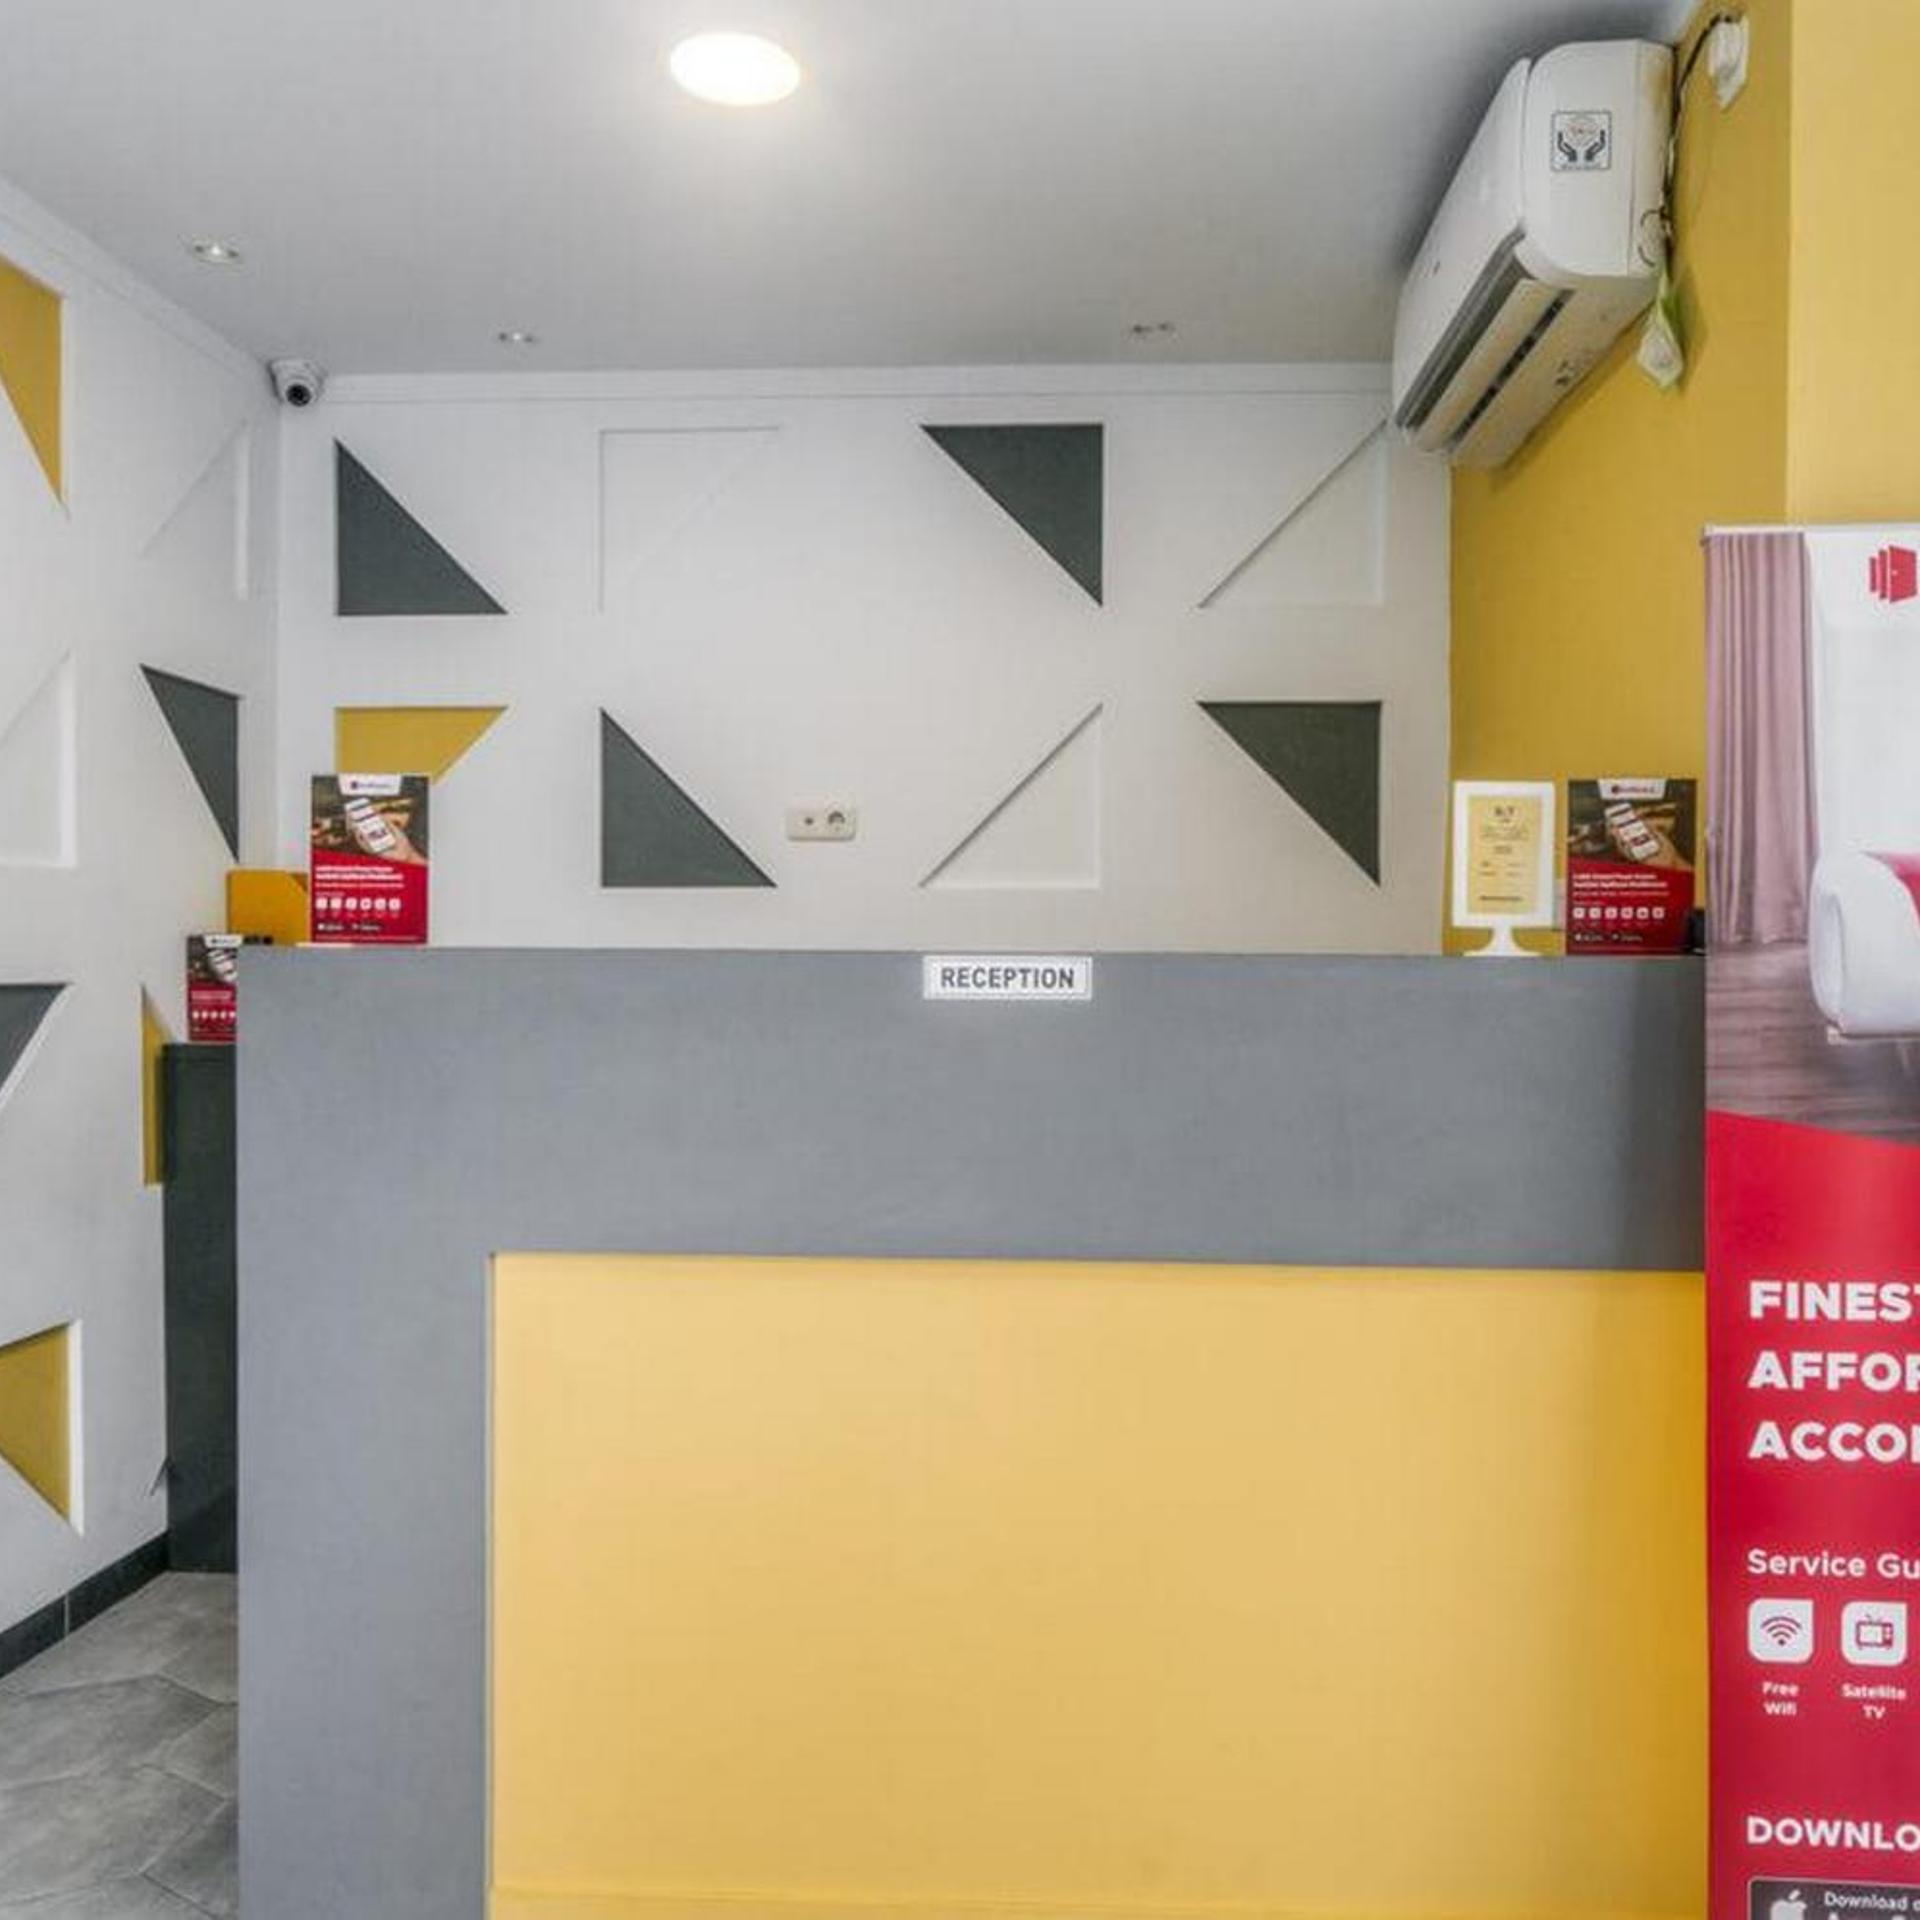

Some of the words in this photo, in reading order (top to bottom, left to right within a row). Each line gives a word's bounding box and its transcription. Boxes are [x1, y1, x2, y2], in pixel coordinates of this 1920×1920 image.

[941, 967, 1074, 989] RECEPTION
[1750, 1280, 1920, 1321] FINES
[1748, 1420, 1920, 1463] ACCO
[1748, 1548, 1866, 1578] Service
[1762, 1681, 1799, 1696] Free
[1842, 1682, 1906, 1700] Satellite
[1863, 1705, 1885, 1719] TV
[1747, 1815, 1920, 1852] DOWNLO
[1824, 1890, 1908, 1911] Download
